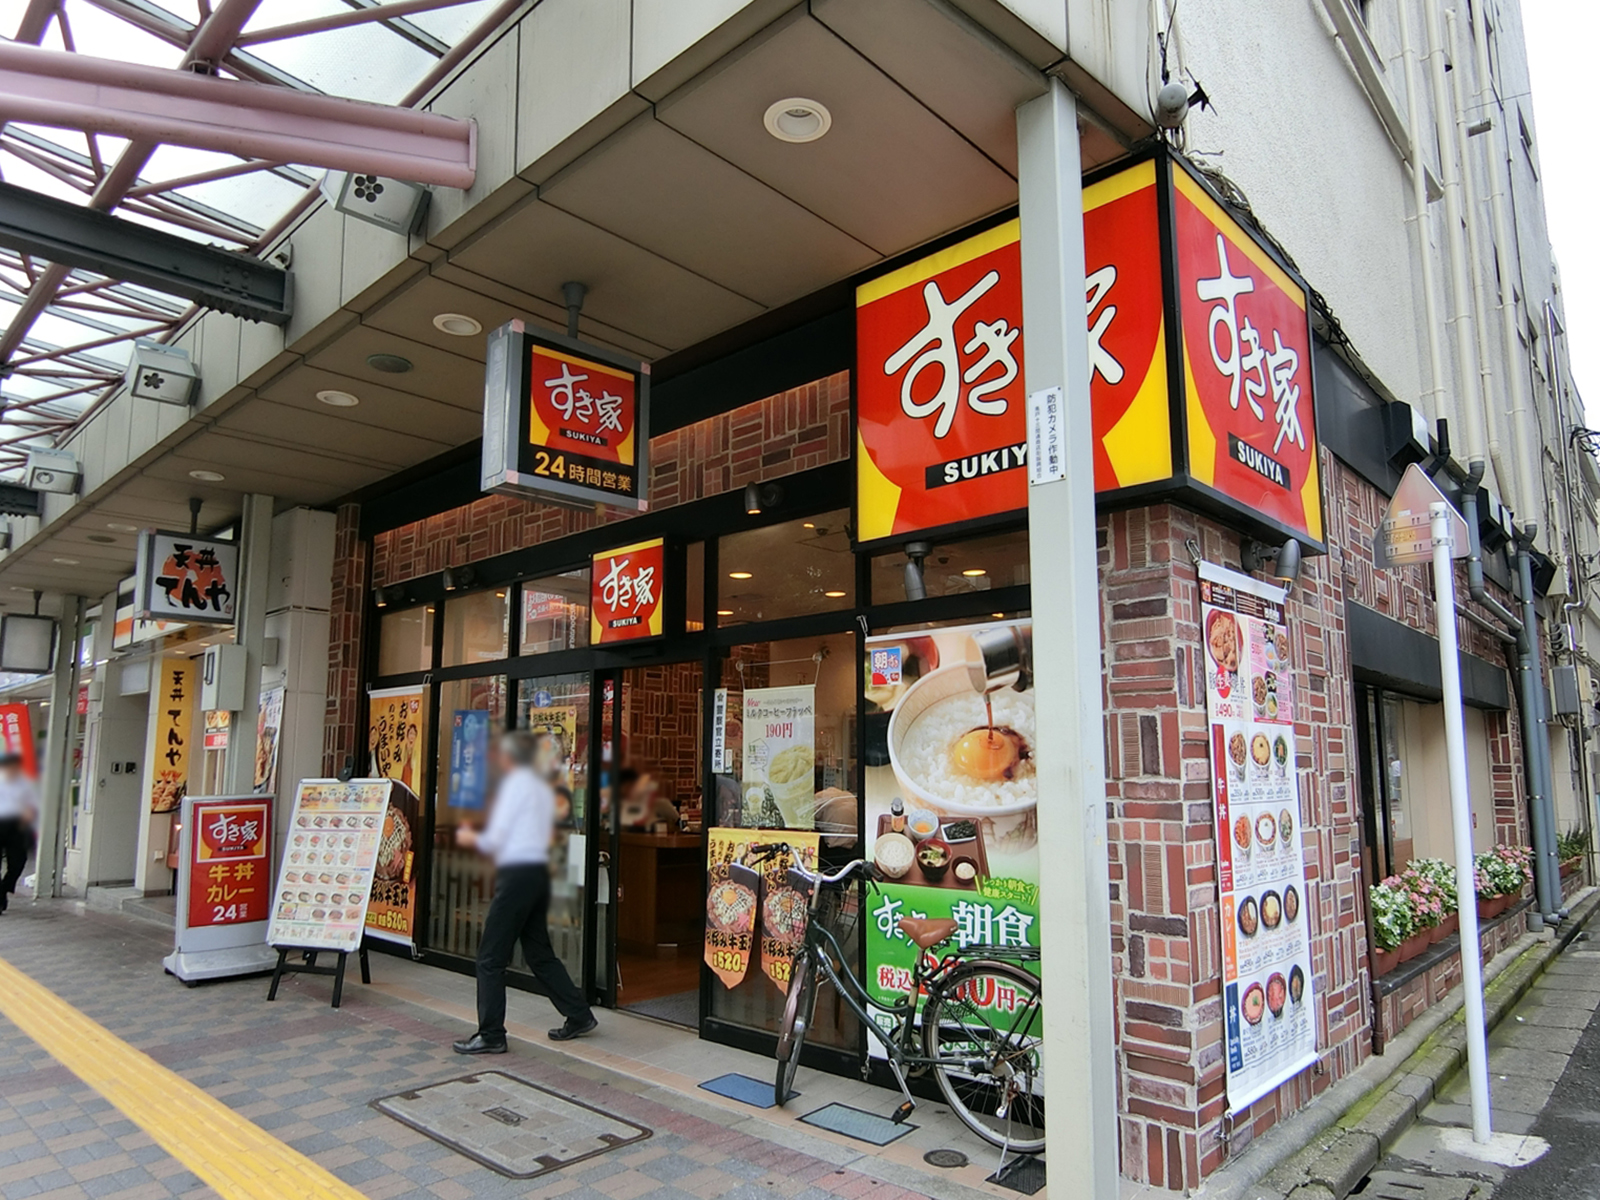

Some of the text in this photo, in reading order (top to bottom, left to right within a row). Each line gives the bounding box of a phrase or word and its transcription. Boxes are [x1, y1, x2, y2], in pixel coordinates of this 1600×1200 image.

[1197, 232, 1305, 454] すき家
[543, 362, 624, 435] すき家
[565, 428, 603, 447] SUKIYA
[1046, 394, 1059, 475] 防犯カメラ作動中
[534, 451, 632, 493] 24時間営業
[943, 442, 1028, 485] SUKIY
[1236, 440, 1285, 487] SUKIYA
[173, 543, 220, 573] 天丼
[155, 576, 231, 612] てんや
[599, 557, 655, 615] すき家
[612, 616, 639, 628] SUKIYA
[746, 705, 813, 719] ミルクコーヒーフラッペ
[165, 709, 184, 767] てんや
[714, 701, 724, 770] 警察官立寄所
[765, 722, 793, 739] 190円
[209, 813, 258, 845] すき家
[208, 862, 255, 883] 牛丼
[982, 875, 1034, 894] しっかり朝食で
[206, 885, 255, 903] カレー
[212, 904, 238, 922] 24
[873, 895, 1034, 948] すき 朝食
[879, 966, 914, 992] 税込
